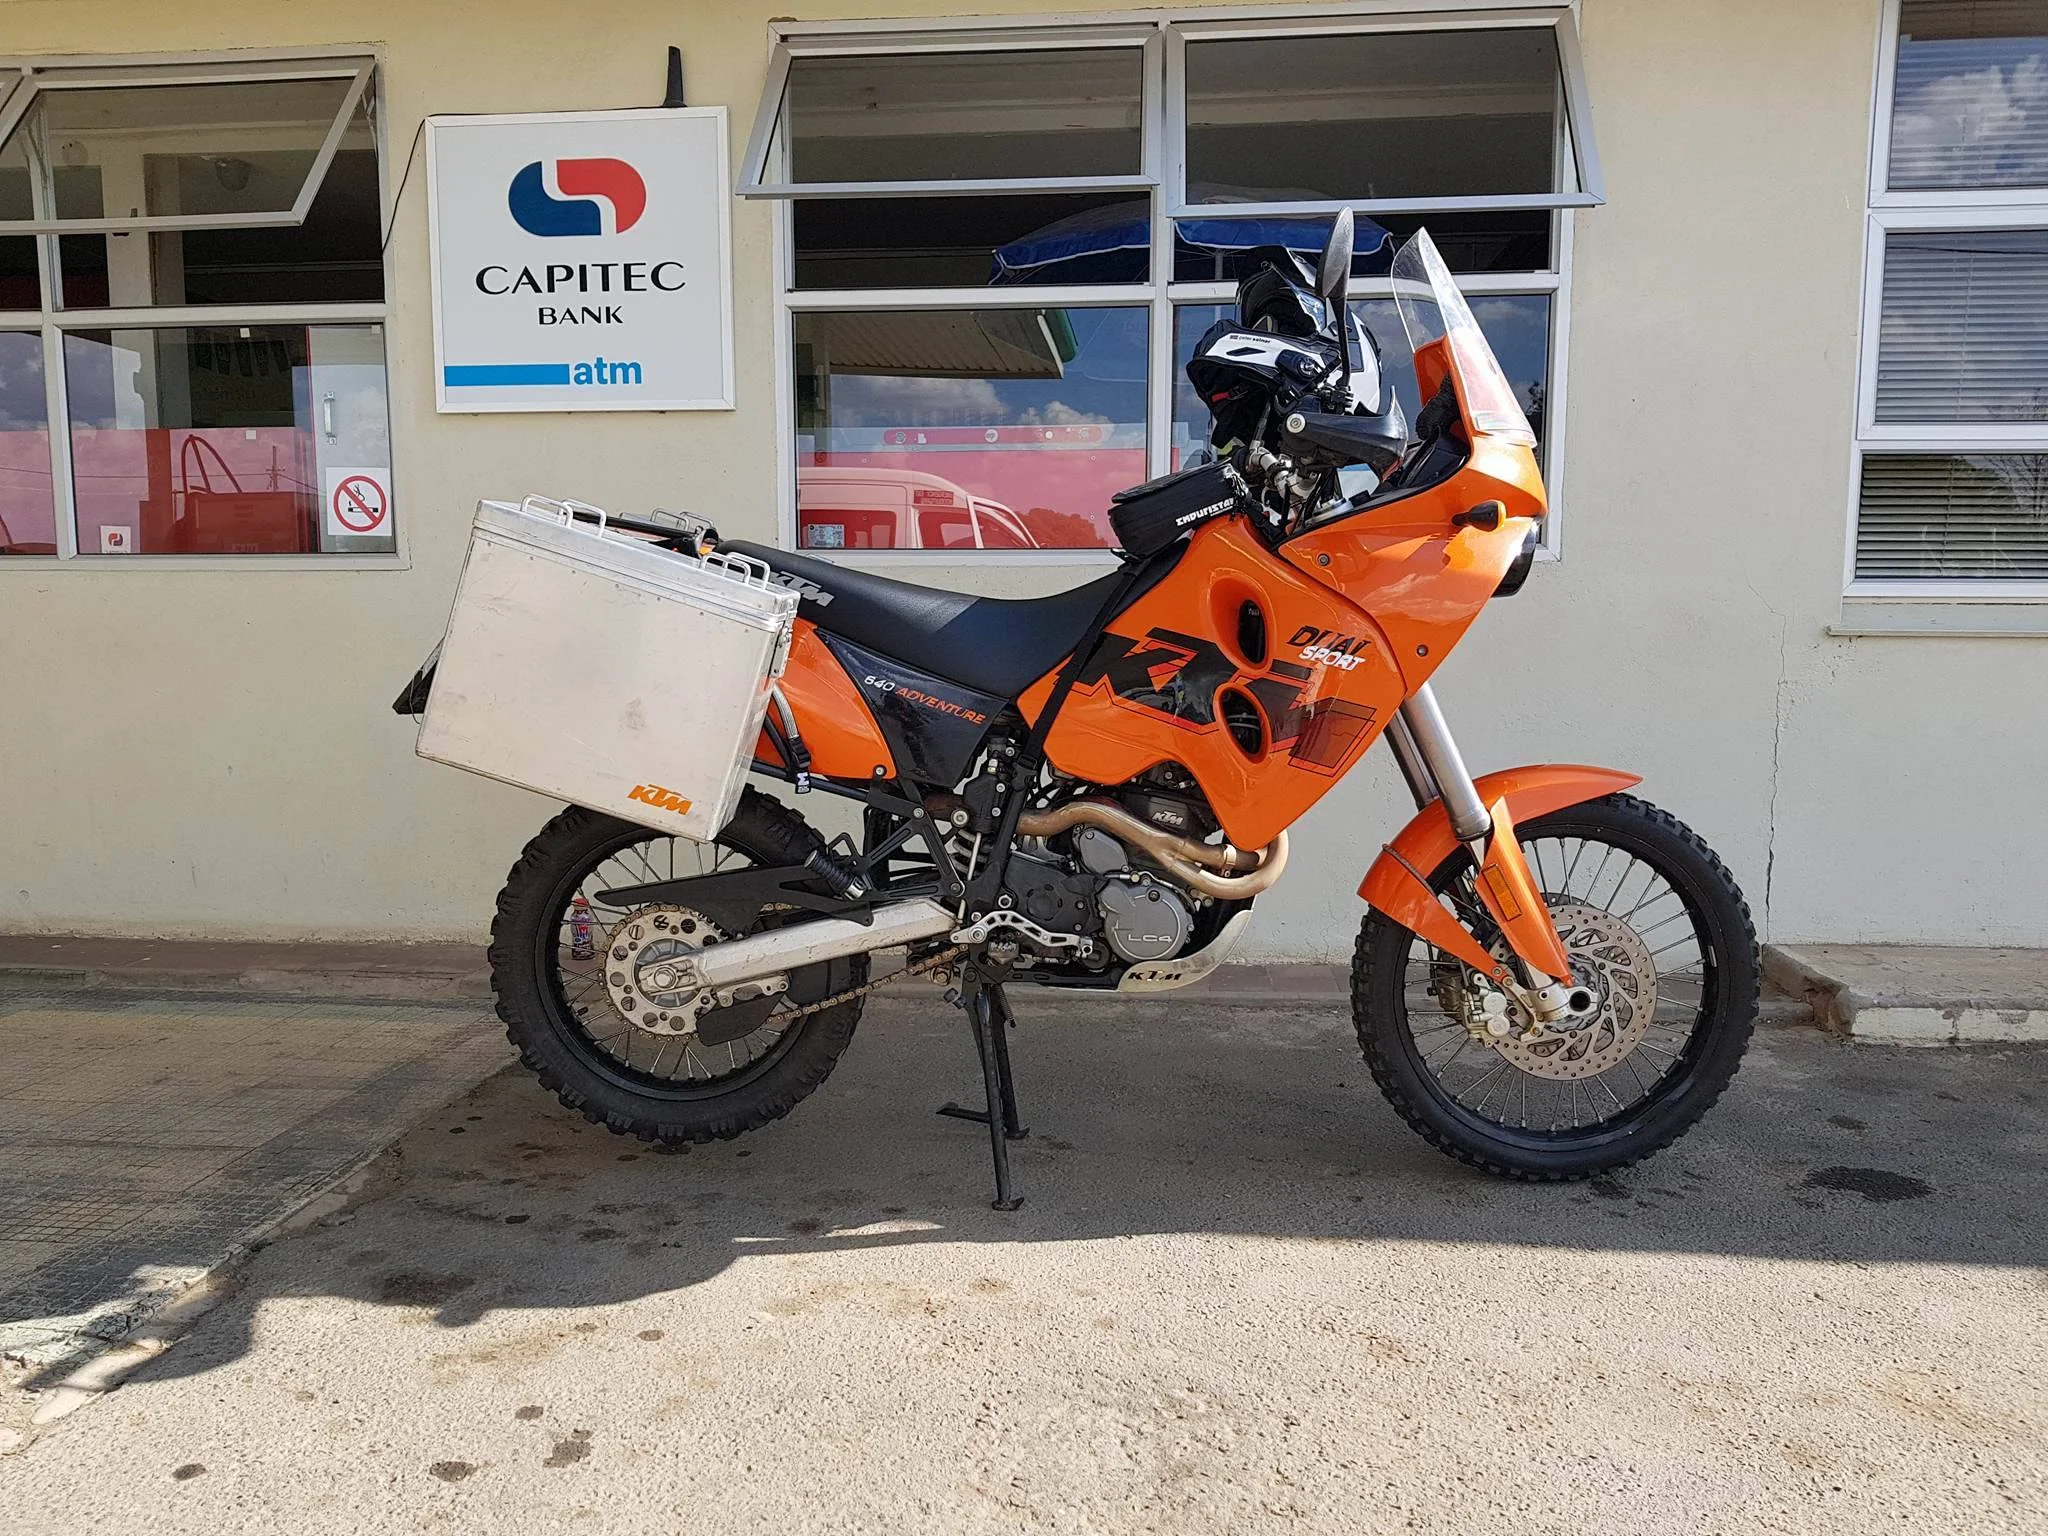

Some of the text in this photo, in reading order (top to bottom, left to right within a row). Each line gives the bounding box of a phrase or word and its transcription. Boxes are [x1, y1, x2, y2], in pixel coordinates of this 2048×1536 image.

[475, 261, 686, 295] CAPITEC
[538, 305, 624, 325] BANK
[573, 357, 642, 385] atm
[1286, 625, 1372, 656] DUAL
[1299, 645, 1366, 671] SPORT
[864, 675, 896, 692] 640
[895, 687, 987, 725] ADVENTURE
[627, 784, 693, 816] KTM
[1152, 811, 1184, 825] KTM
[1128, 934, 1172, 943] LC4
